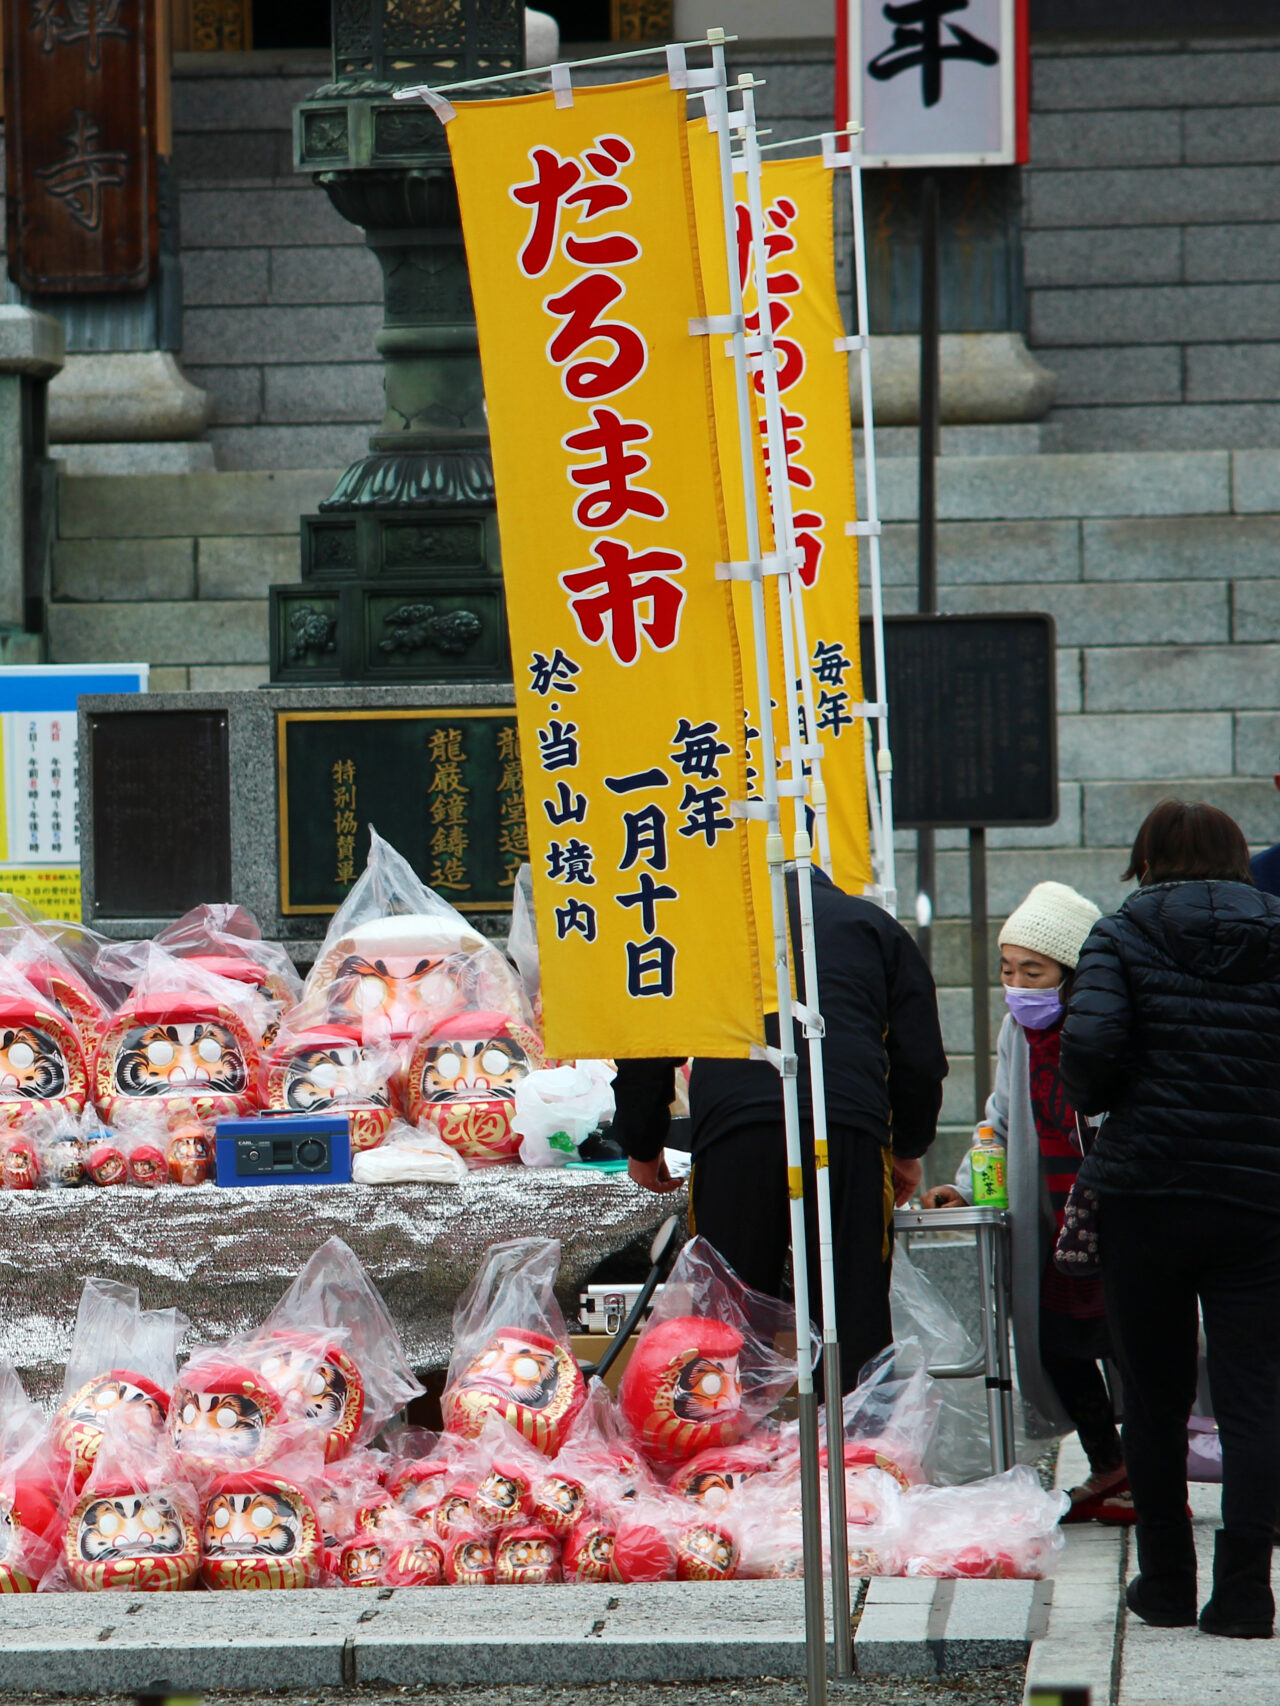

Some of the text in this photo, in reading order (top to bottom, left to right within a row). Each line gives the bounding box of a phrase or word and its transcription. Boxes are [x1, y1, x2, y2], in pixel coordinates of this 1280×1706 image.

[867, 0, 1000, 109] 年
[510, 136, 686, 665] だるま市
[812, 641, 853, 737] 毎年
[529, 649, 597, 942] 於・当山境内
[671, 719, 733, 846] 毎年
[605, 769, 677, 998] 一月十日
